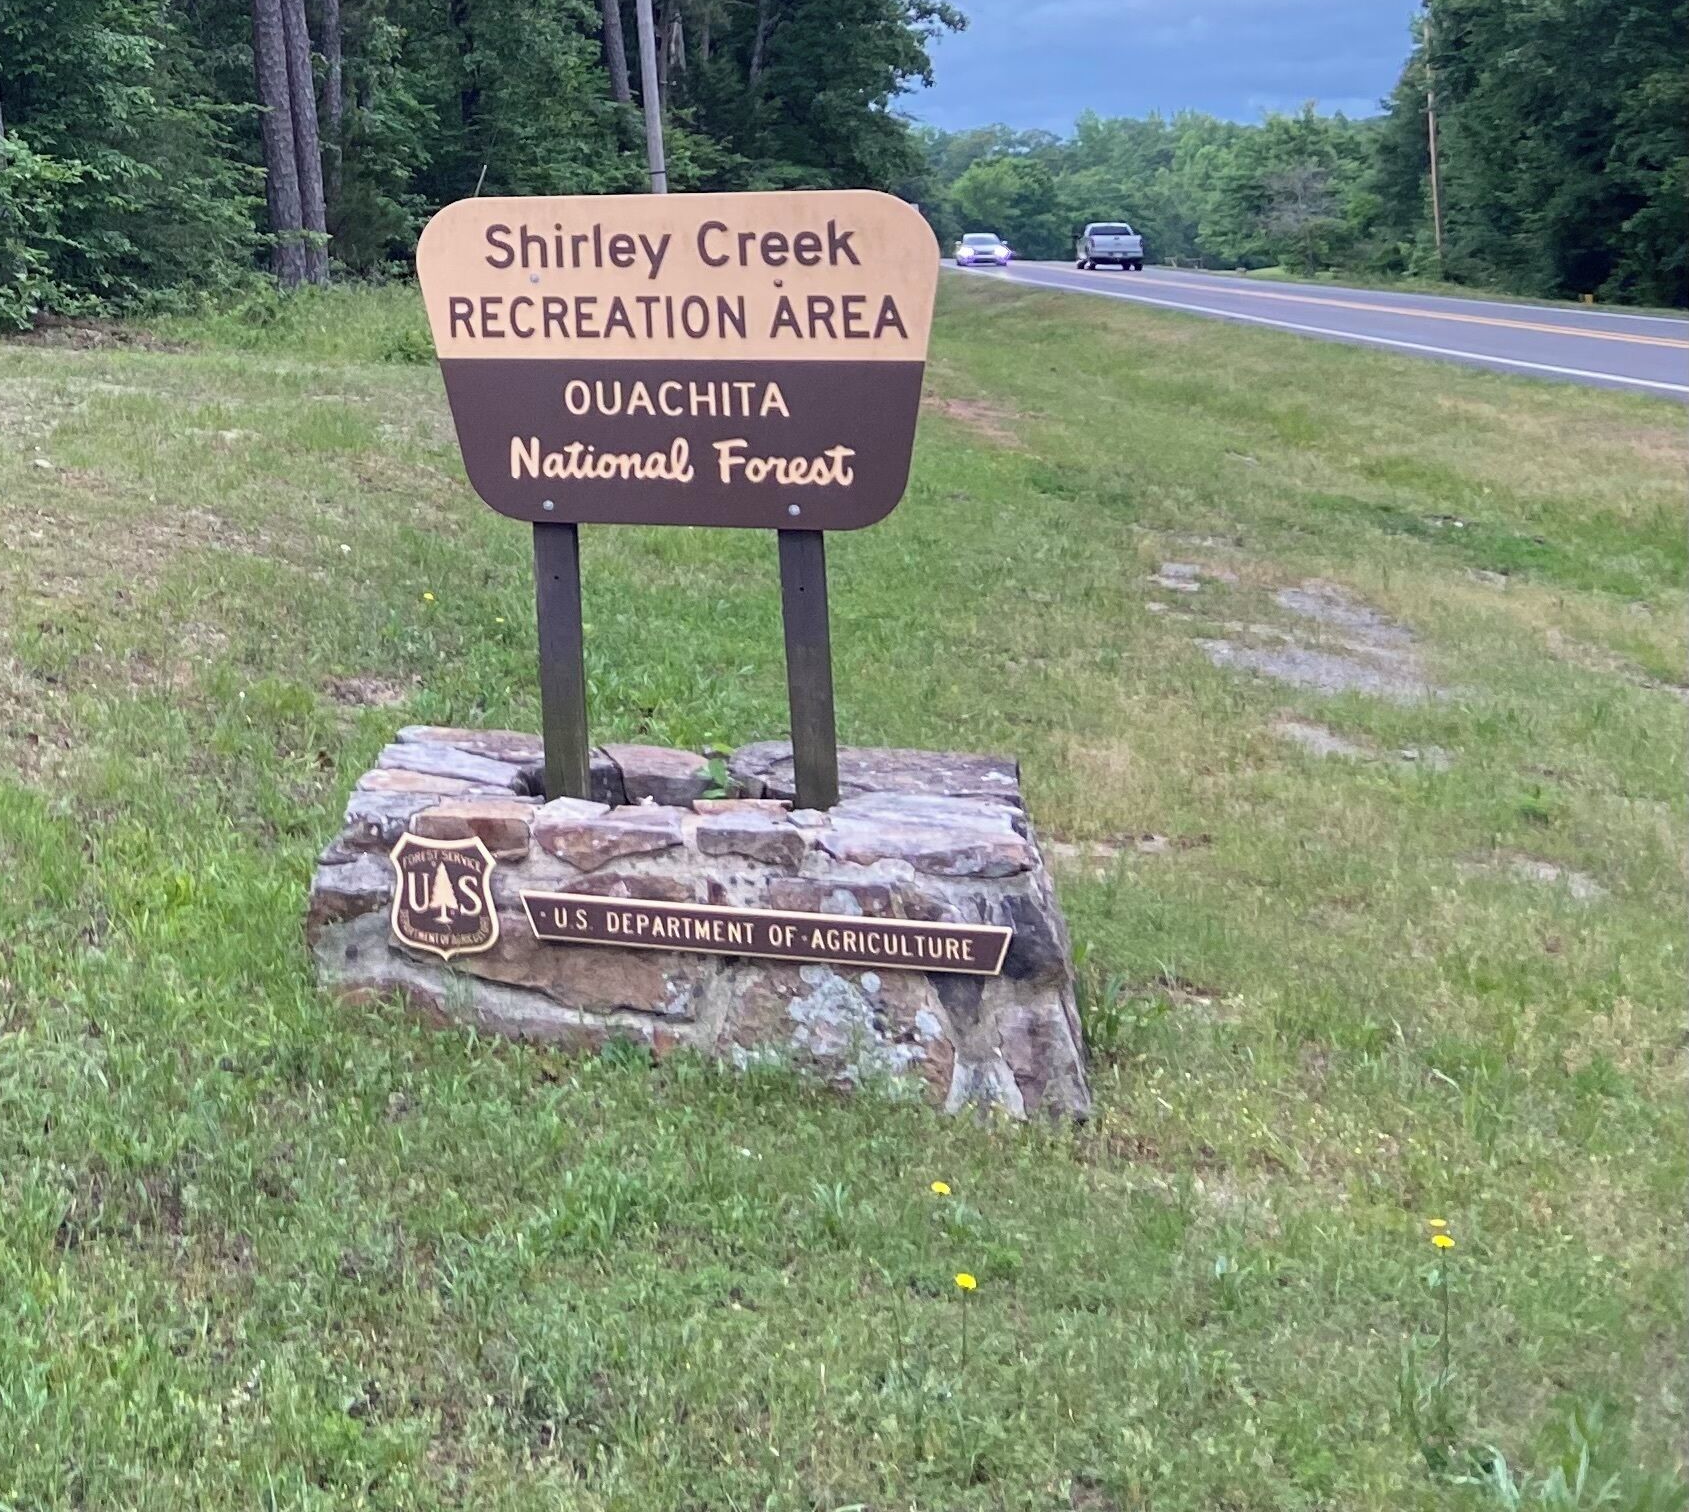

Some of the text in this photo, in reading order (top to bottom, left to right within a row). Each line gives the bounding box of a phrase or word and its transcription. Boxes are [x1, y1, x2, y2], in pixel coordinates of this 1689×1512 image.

[485, 219, 860, 279] Shirley Creek
[448, 294, 909, 340] RECREATION AREA
[564, 380, 790, 418] OUACHITA
[510, 436, 856, 488] National Forest
[606, 911, 754, 945] DEPARTMENT
[768, 923, 798, 948] OF
[811, 928, 976, 962] AGRICULTURE
